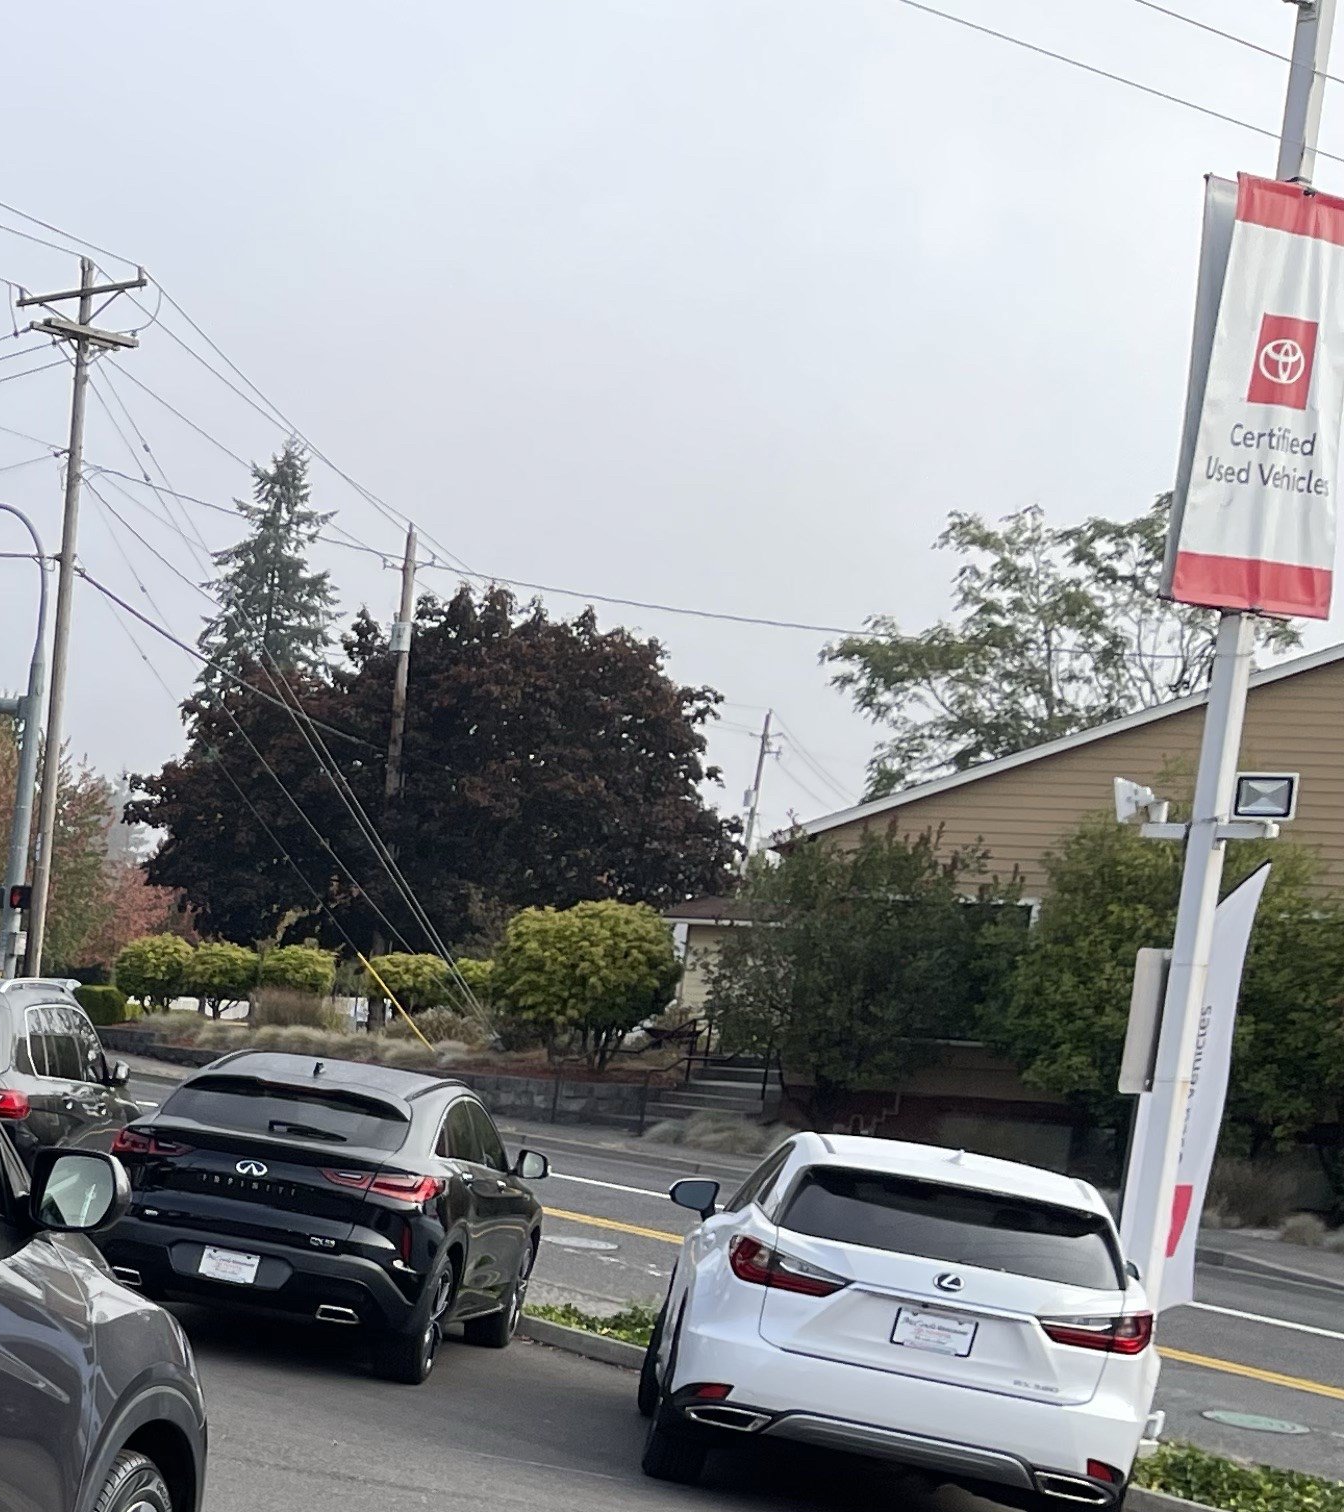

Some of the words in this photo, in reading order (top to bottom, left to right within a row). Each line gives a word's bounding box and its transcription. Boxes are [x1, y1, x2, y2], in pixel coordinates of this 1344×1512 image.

[1230, 422, 1316, 457] Certified
[1206, 455, 1251, 486] Used
[1259, 461, 1329, 497] Vehicles
